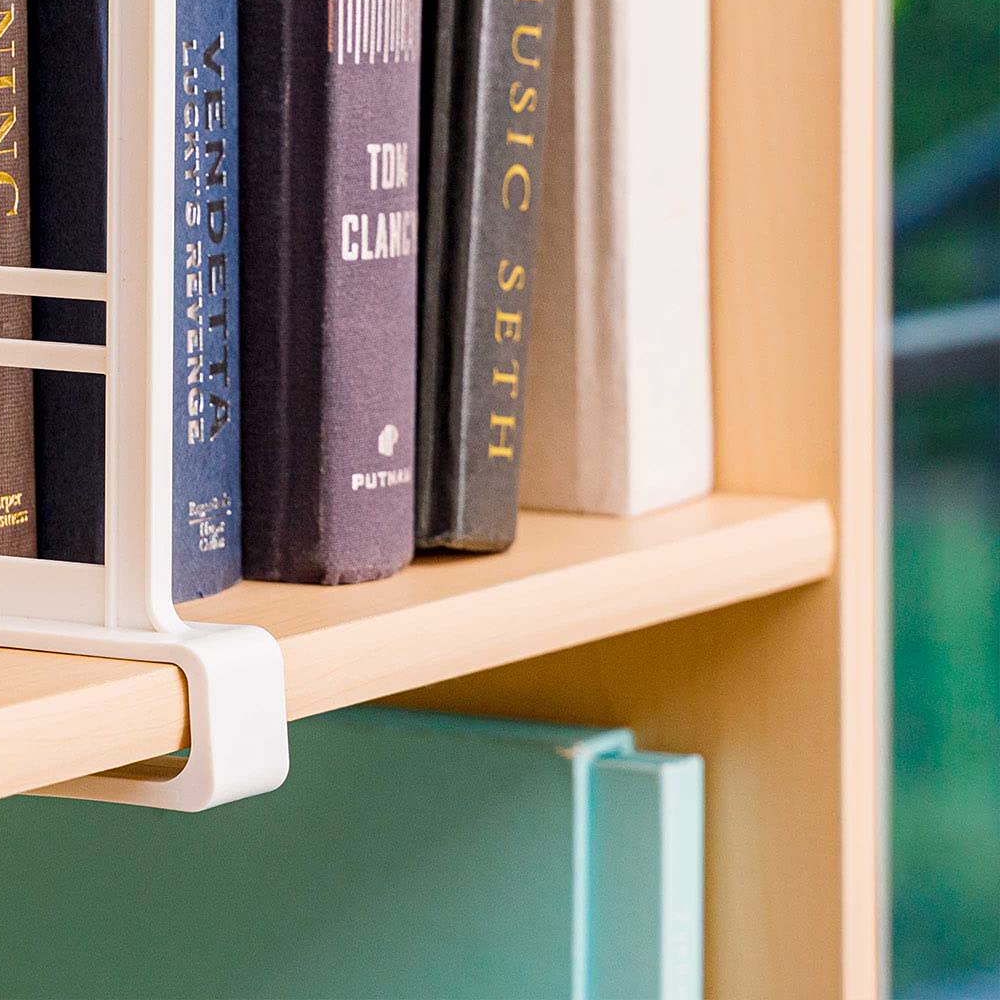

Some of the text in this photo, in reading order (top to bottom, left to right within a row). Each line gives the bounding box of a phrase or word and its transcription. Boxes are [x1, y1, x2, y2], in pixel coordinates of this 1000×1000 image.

[182, 39, 205, 445] LUCKY'S REVENGE
[203, 31, 231, 442] VENDETTA
[366, 142, 408, 190] TOM
[488, 259, 526, 460] SETH
